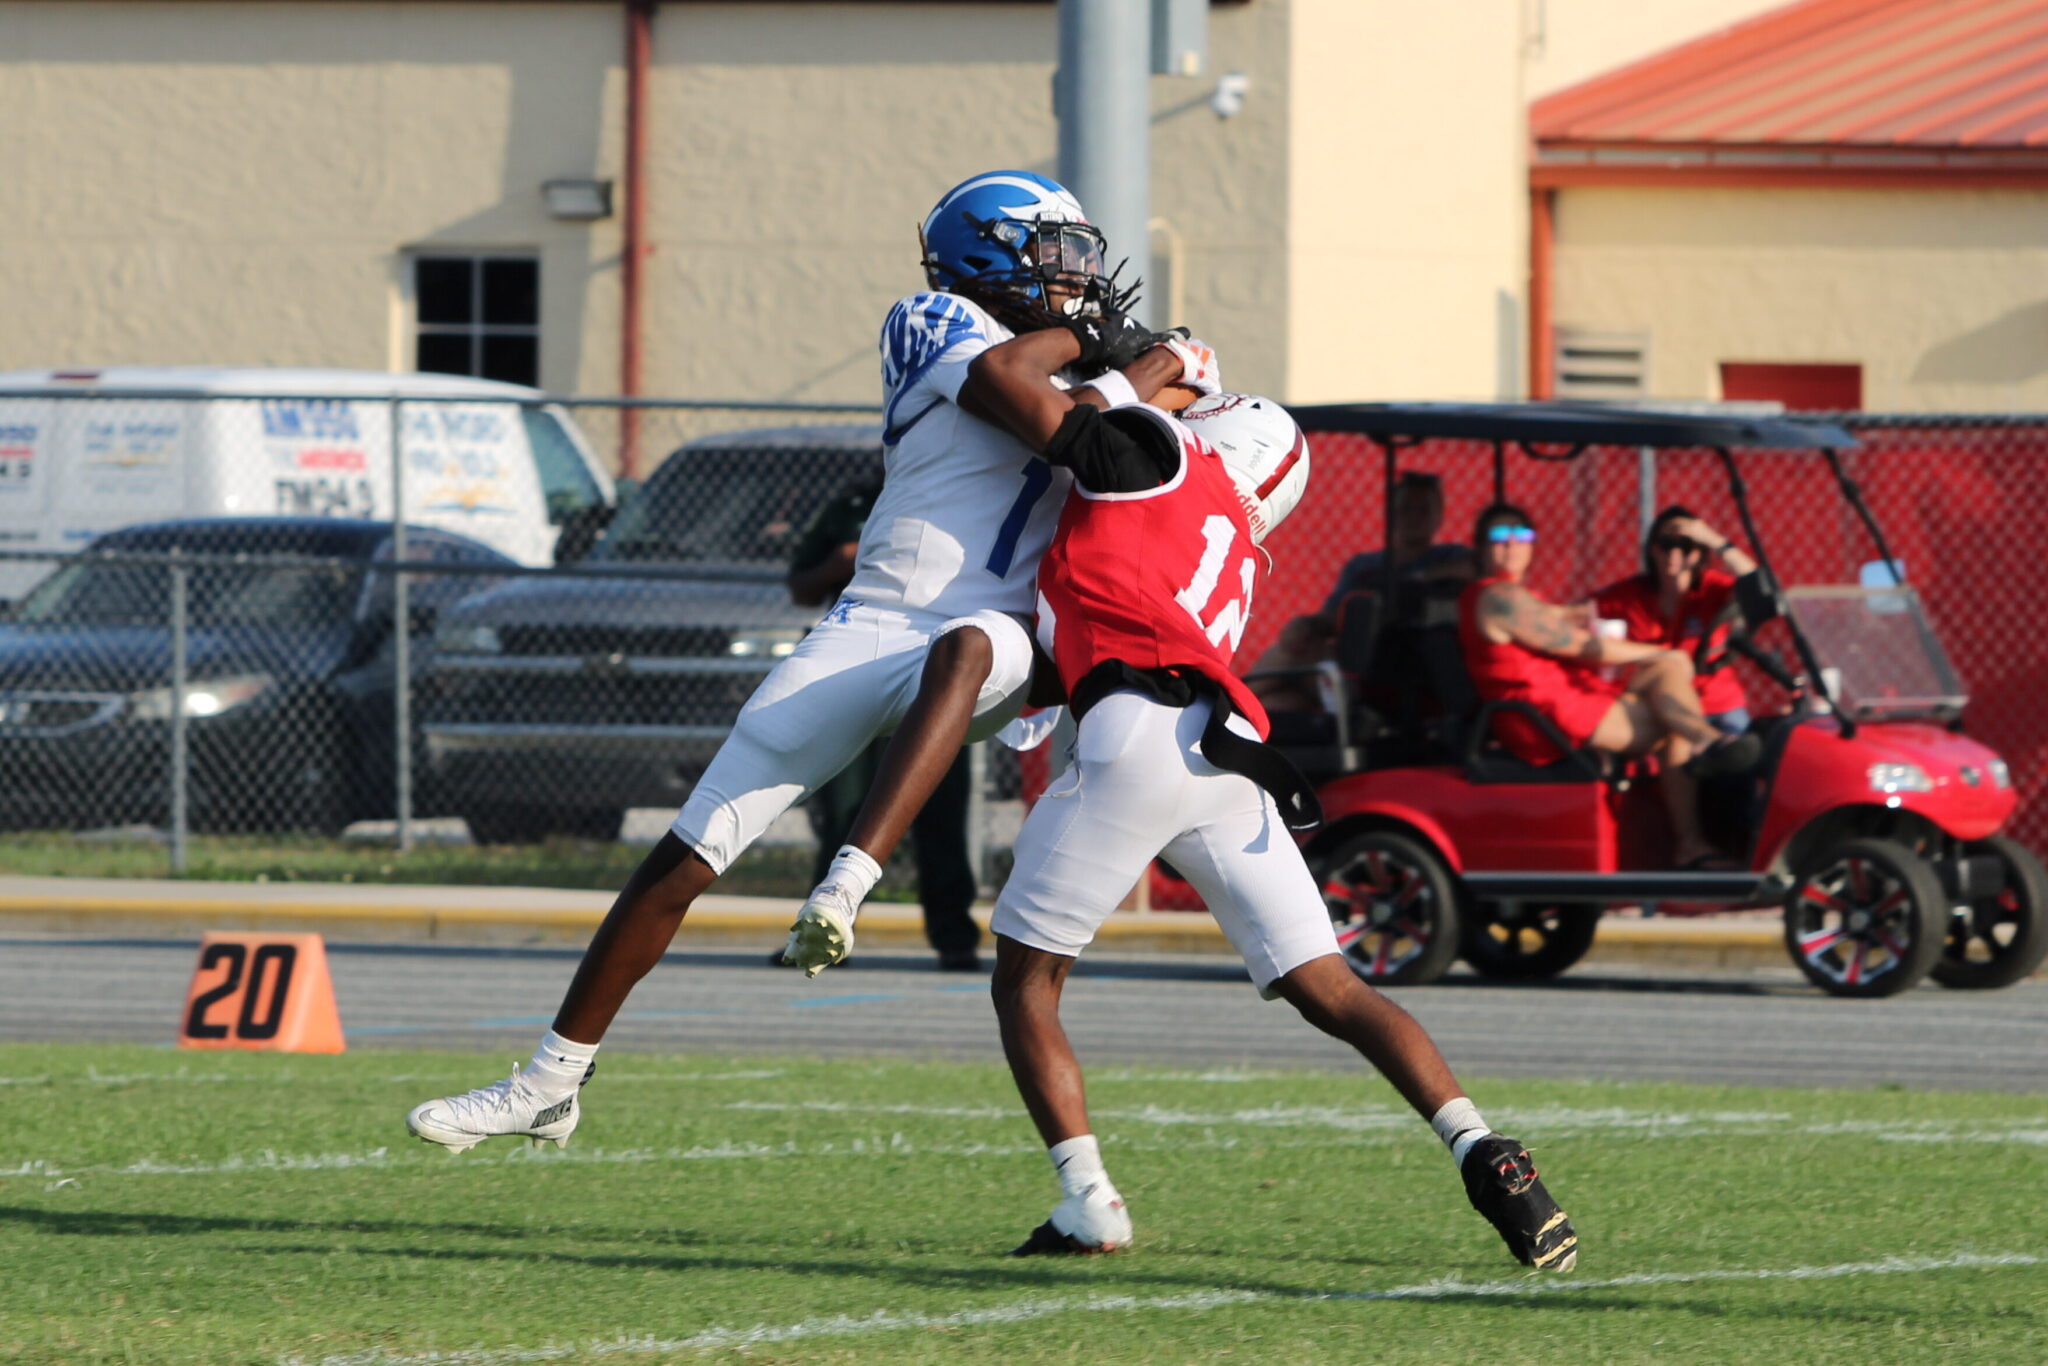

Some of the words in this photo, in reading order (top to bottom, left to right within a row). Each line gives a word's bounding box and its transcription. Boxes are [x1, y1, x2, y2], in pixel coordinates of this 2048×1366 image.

[986, 455, 1053, 580] 1
[185, 943, 298, 1040] 20
[531, 1098, 574, 1129] NIKE
